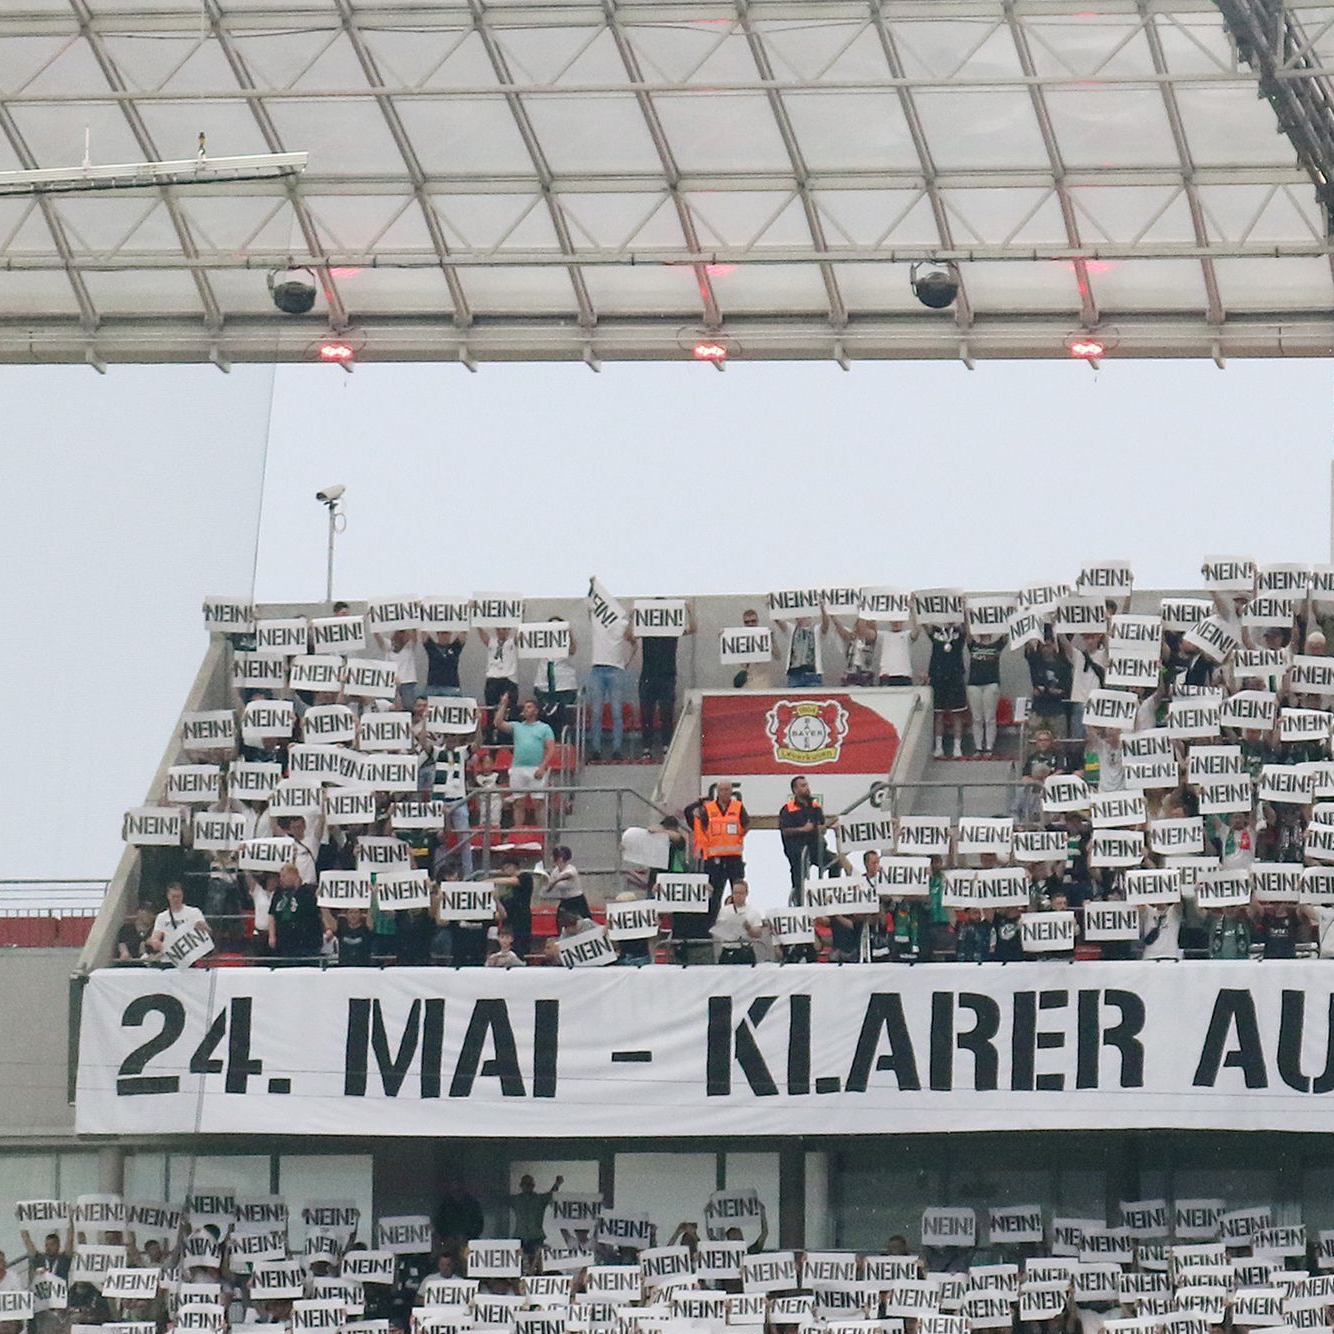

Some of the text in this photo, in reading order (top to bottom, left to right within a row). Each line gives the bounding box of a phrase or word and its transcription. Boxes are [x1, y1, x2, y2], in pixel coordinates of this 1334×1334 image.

[1083, 569, 1129, 587] NEIN!
[472, 601, 520, 617] NEIN!
[635, 609, 682, 626] NEIN!
[315, 623, 362, 643] NEIN!
[723, 635, 769, 654] NEIN!
[196, 822, 243, 840] NEIN!
[841, 822, 891, 842] NEIN!
[880, 867, 926, 884] NEIN!
[1128, 875, 1177, 894] NEIN!
[320, 880, 368, 898] NEIN!
[442, 892, 492, 910] NEIN!
[612, 910, 656, 929] NEIN!
[1087, 911, 1137, 929] NEIN!
[1023, 921, 1072, 940] NEIN!
[116, 993, 292, 1096] 24.
[343, 997, 560, 1099] MAI
[707, 987, 1146, 1096] KLARER
[16, 1202, 67, 1221] NEIN!
[924, 1217, 973, 1235] NEIN!
[990, 1214, 1040, 1231] NEIN!
[106, 1275, 155, 1290] NEIN!
[594, 1273, 638, 1290] NEIN!
